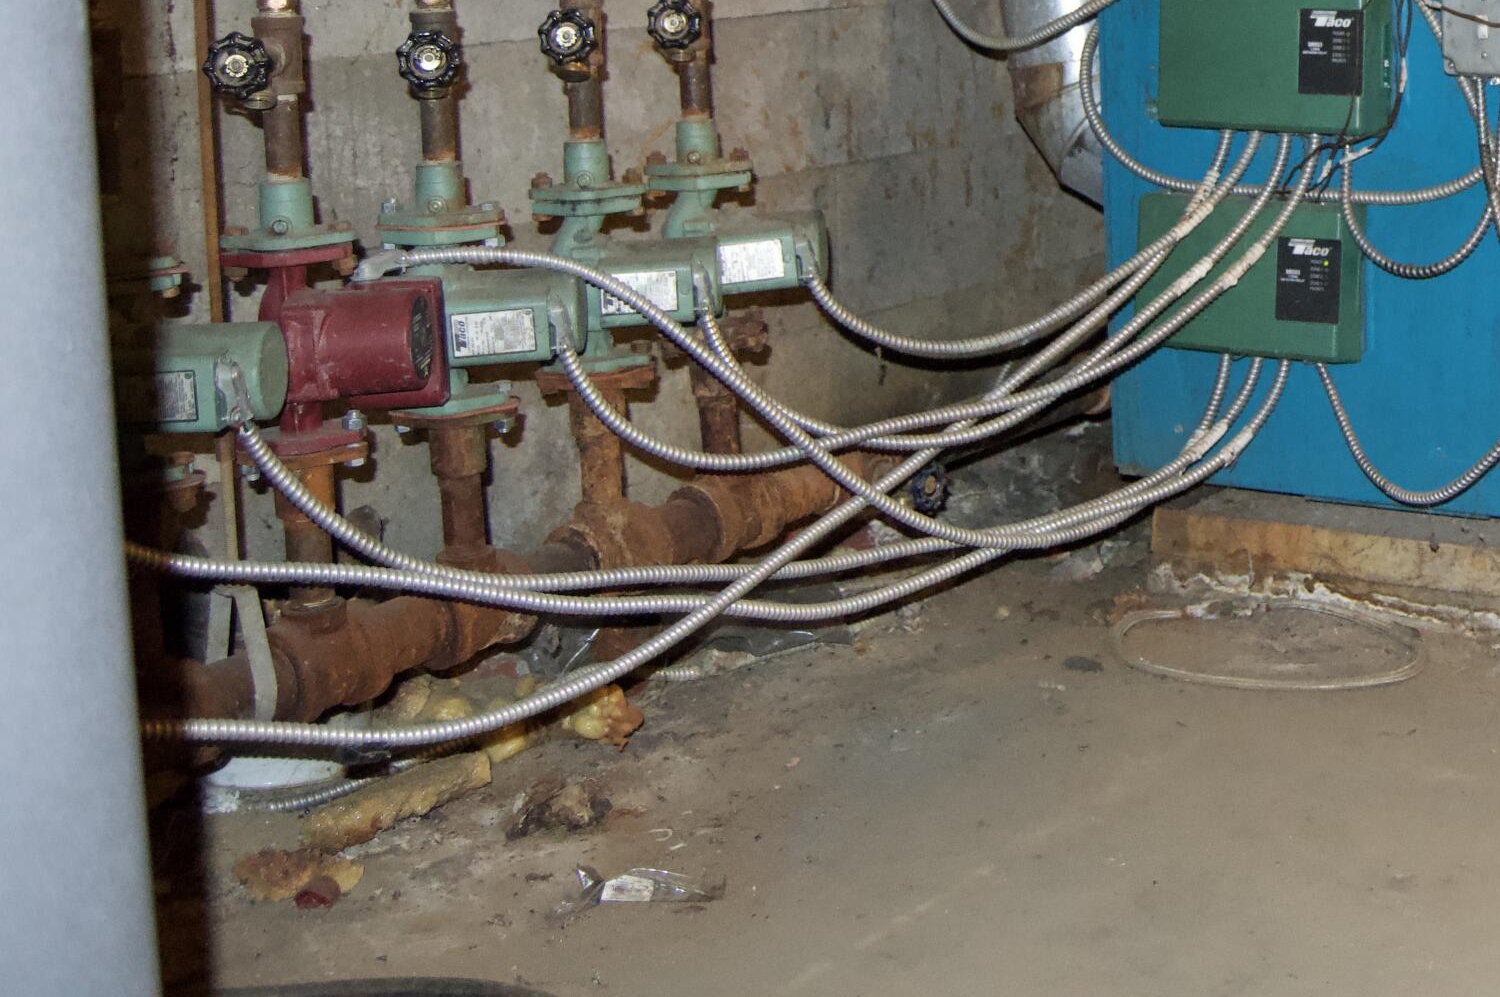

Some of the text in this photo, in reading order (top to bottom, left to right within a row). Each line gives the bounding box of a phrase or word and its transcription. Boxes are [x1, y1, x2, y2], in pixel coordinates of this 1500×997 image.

[1310, 10, 1352, 28] Taco
[1288, 238, 1330, 256] Taco
[453, 318, 467, 352] Taco
